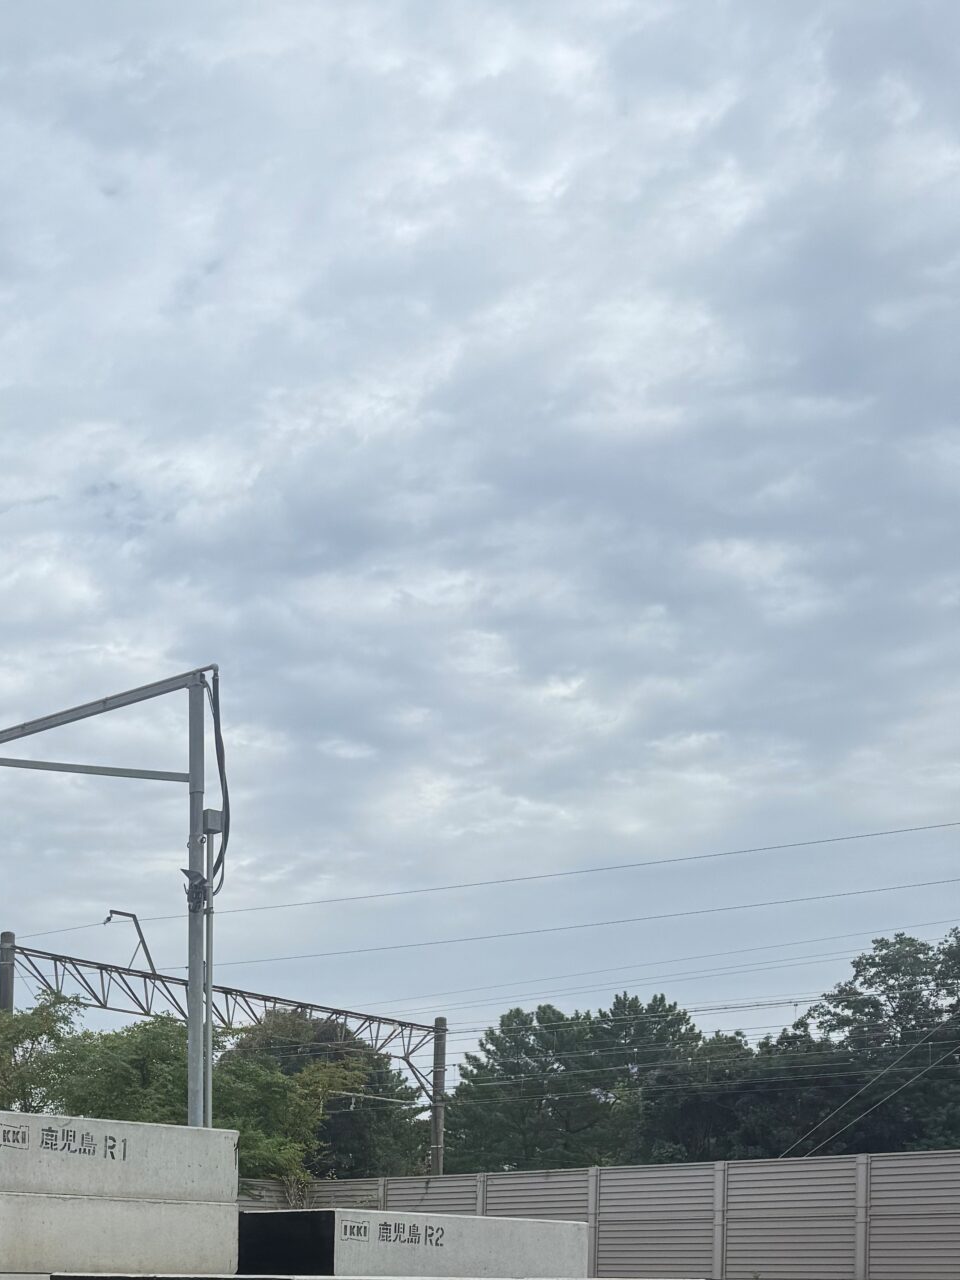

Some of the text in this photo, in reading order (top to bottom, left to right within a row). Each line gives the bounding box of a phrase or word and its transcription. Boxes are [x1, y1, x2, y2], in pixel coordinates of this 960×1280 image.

[40, 1126, 97, 1156] 鹿児島
[104, 1135, 127, 1161] R1
[343, 1221, 445, 1247] IKKI 鹿児島 R2
